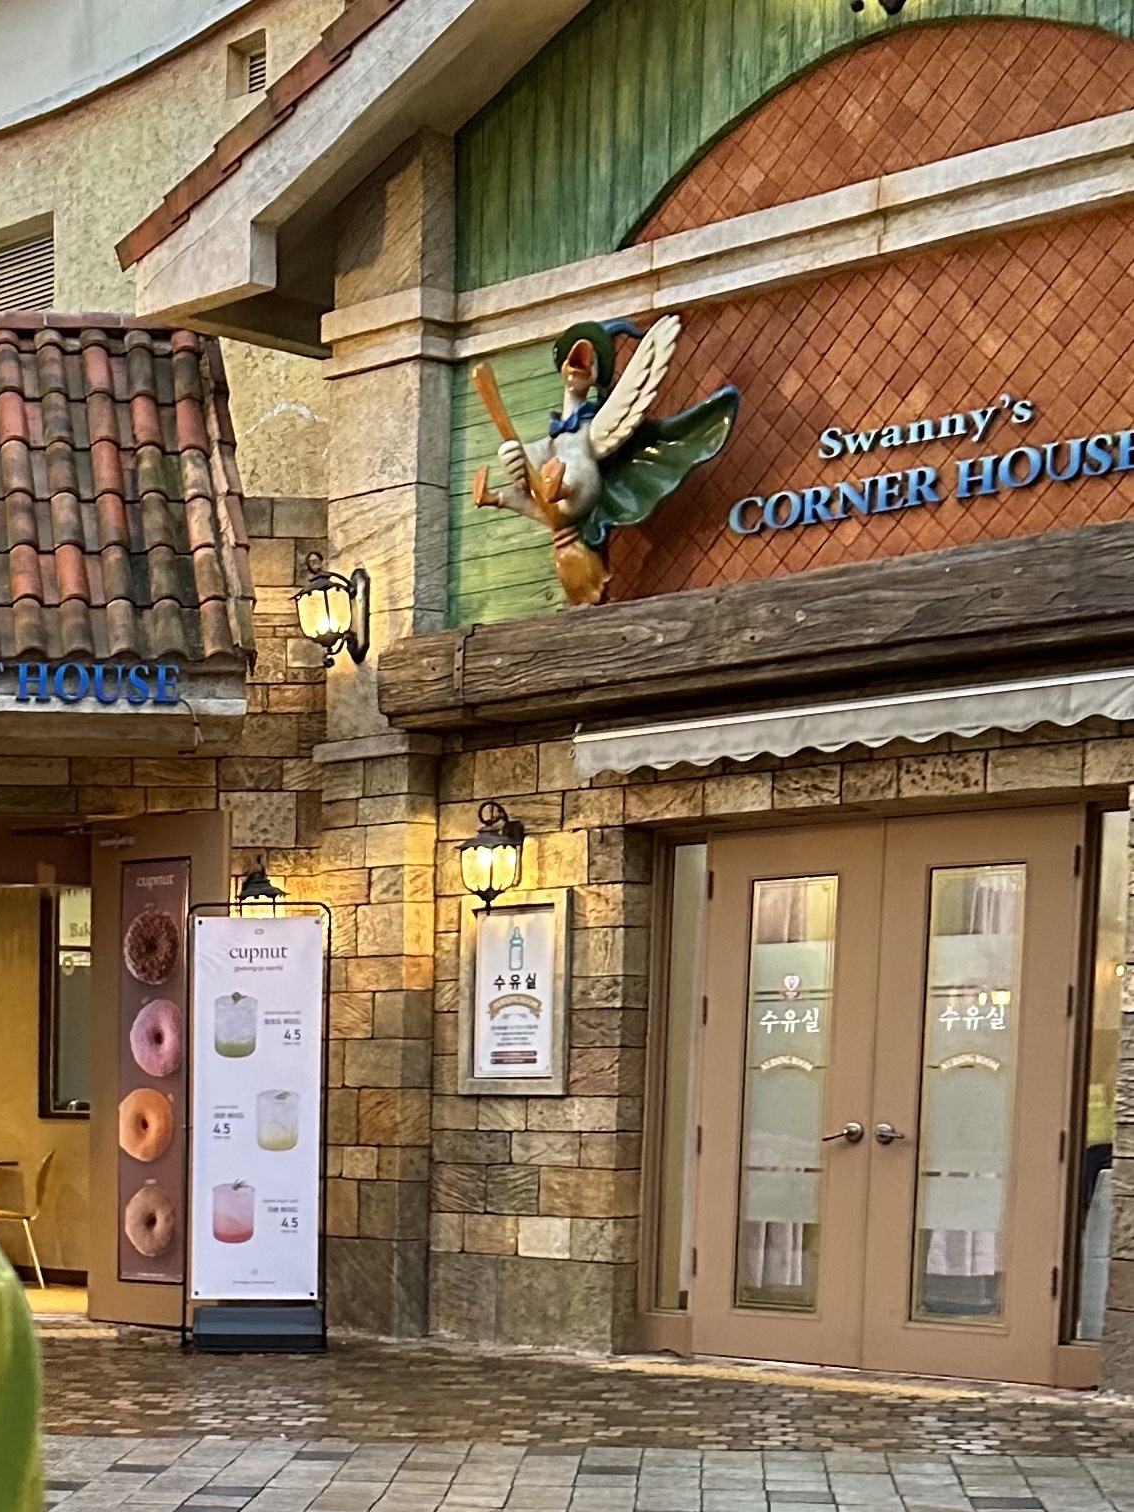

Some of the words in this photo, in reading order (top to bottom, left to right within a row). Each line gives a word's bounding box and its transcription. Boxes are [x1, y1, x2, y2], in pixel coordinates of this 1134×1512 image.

[729, 465, 940, 535] CORNER
[17, 662, 180, 704] HOUSE
[136, 874, 175, 890] cupnut
[229, 946, 288, 964] cupnut
[493, 972, 536, 991] 수유실
[759, 1007, 820, 1034] 수유실
[938, 1005, 1006, 1032] 수유실
[284, 1028, 302, 1041] 4.5
[213, 1122, 231, 1135] 4.5
[280, 1216, 299, 1229] 4.5
